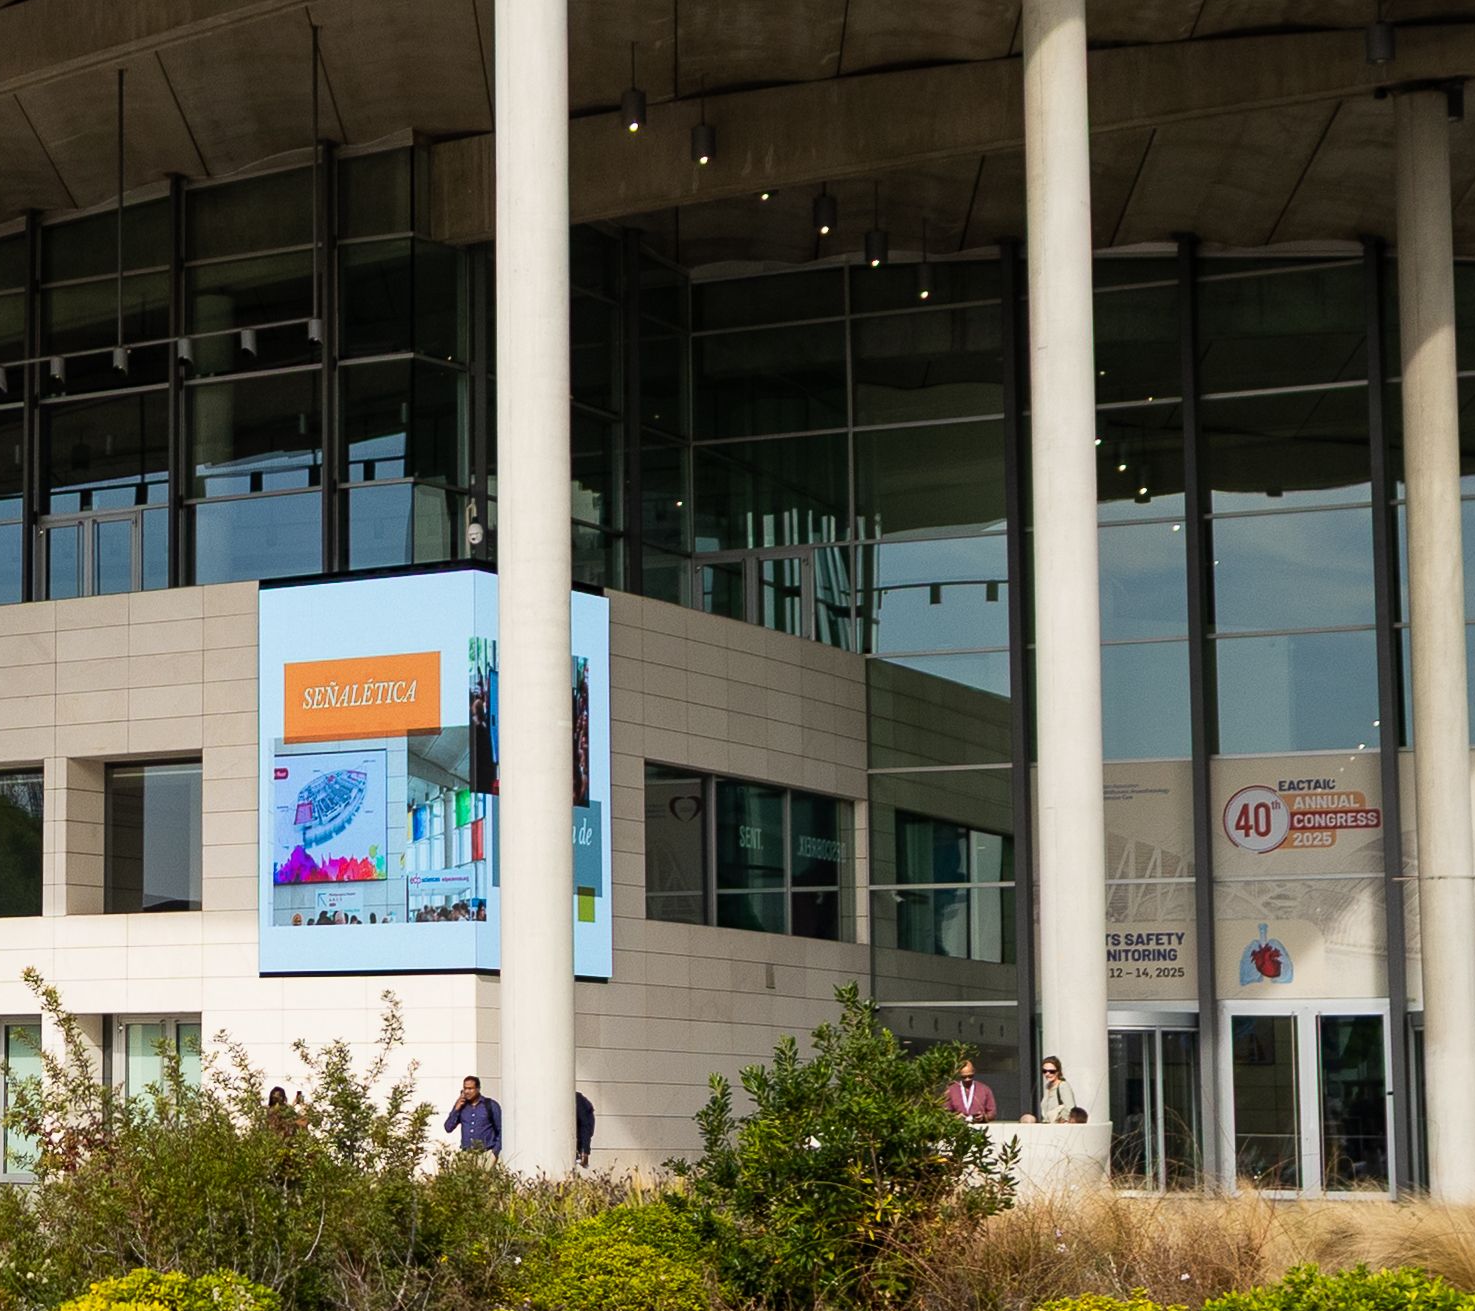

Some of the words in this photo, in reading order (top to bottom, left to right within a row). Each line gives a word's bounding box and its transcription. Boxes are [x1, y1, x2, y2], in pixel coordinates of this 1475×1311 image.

[302, 678, 417, 709] SEÑALÉTICA
[1293, 794, 1360, 810] ANNUAL
[1293, 811, 1378, 828] CONGRESS
[578, 817, 593, 846] de
[1293, 831, 1332, 846] 2025
[1124, 931, 1185, 946] SAFETY
[1106, 948, 1178, 962] NITORING
[1109, 968, 1123, 979] 12
[1135, 968, 1153, 980] 14,
[1155, 967, 1185, 978] 2025
